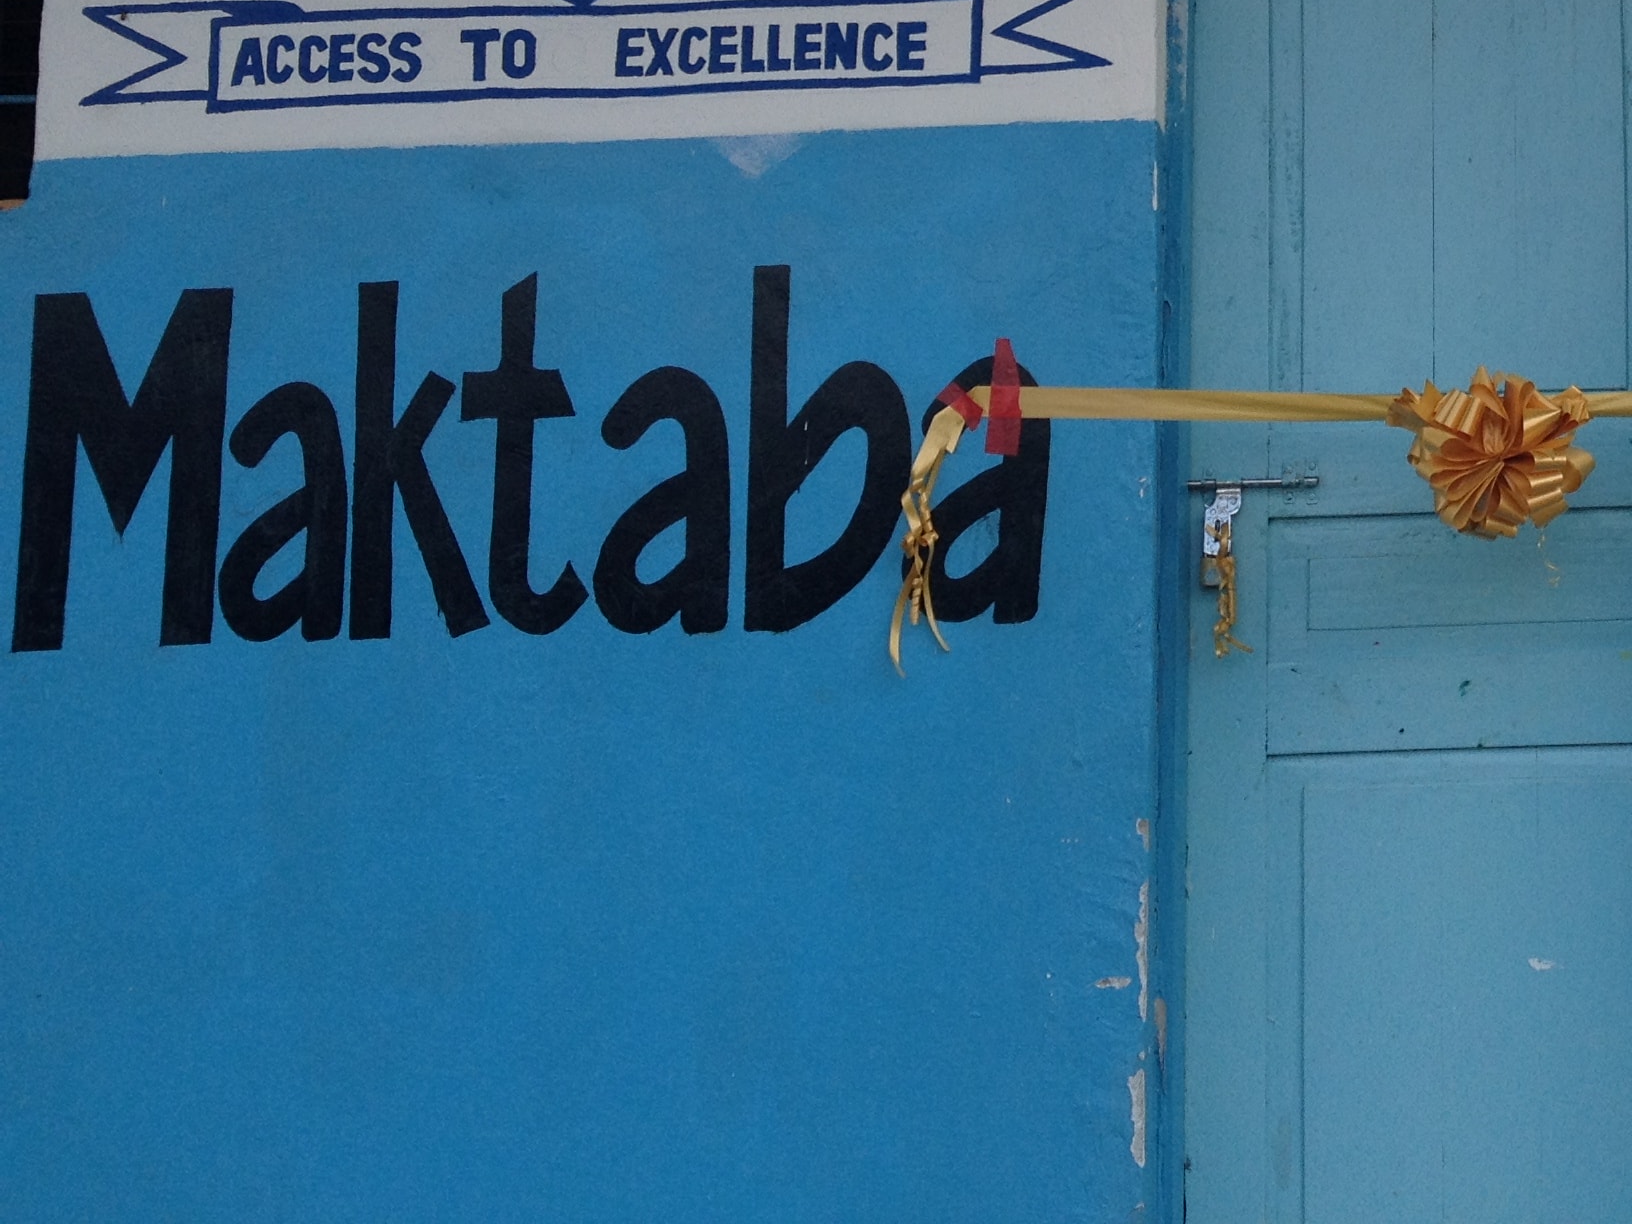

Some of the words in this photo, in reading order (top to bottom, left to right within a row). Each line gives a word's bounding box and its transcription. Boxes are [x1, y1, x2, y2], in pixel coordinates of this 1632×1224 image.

[231, 29, 423, 86] ACCESS
[460, 28, 537, 81] TO
[614, 21, 928, 78] EXCELLENCE
[10, 264, 1051, 653] Maktaba
